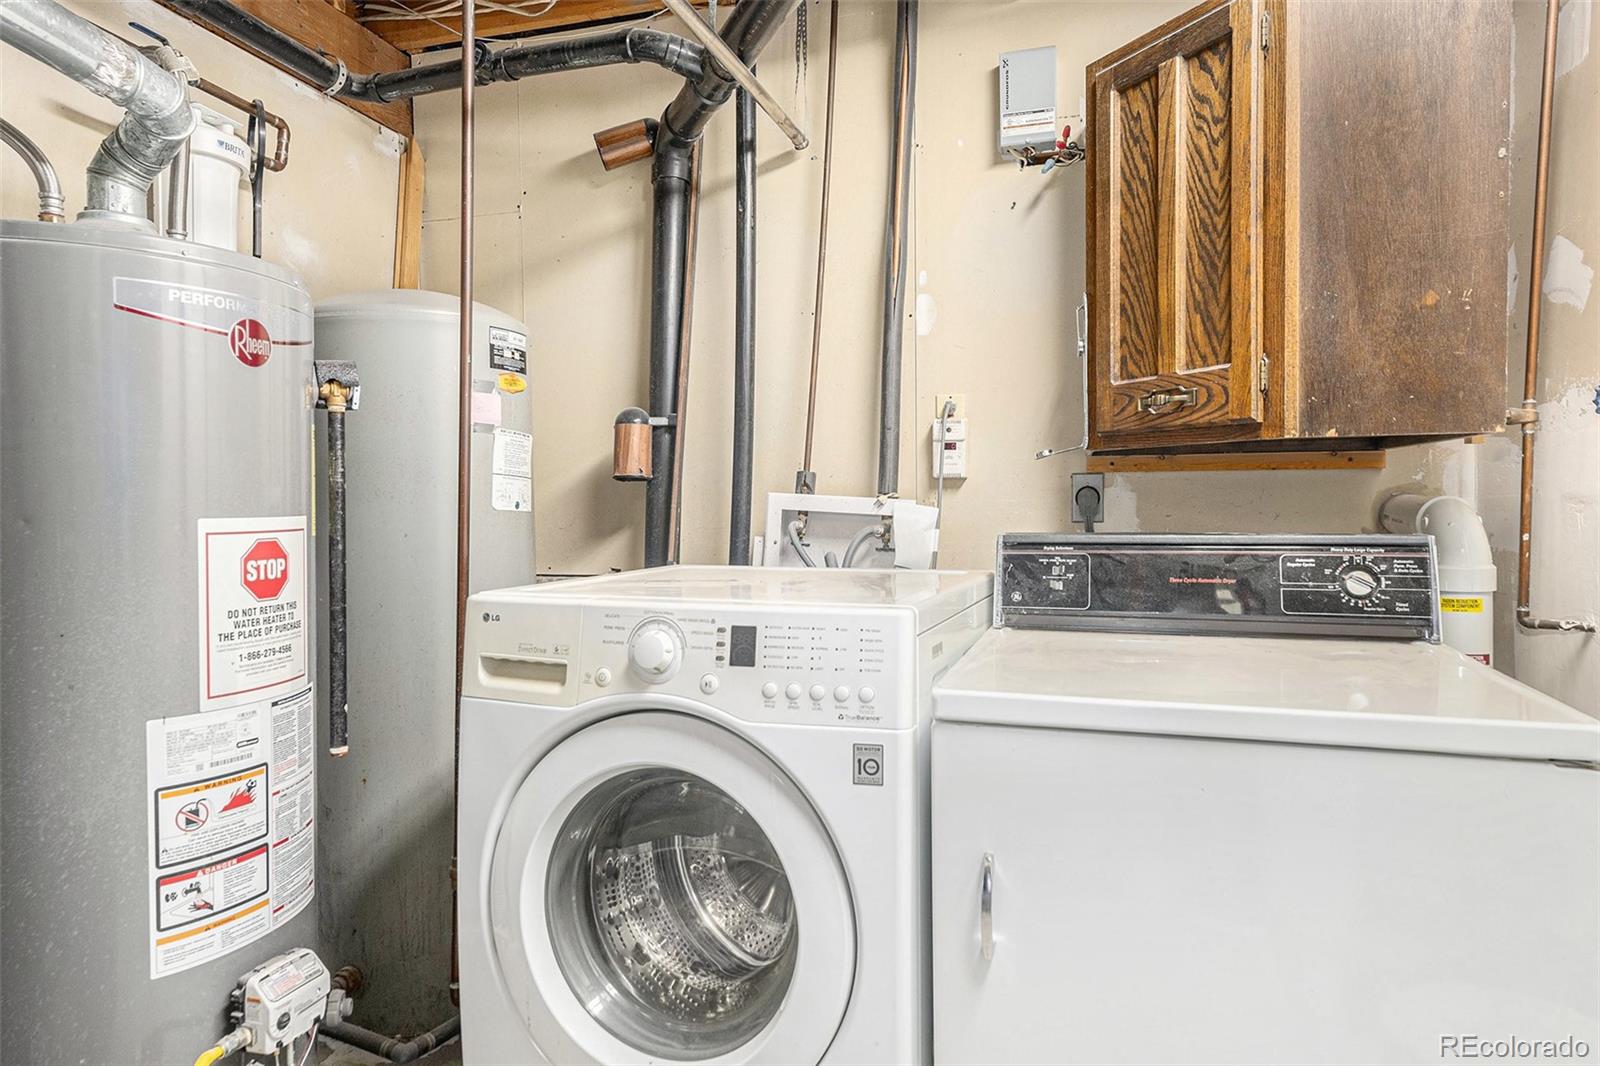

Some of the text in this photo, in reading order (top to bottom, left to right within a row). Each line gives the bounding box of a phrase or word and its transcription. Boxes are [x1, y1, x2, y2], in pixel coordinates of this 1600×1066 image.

[234, 319, 271, 360] Rheem
[246, 558, 286, 582] STOP
[227, 601, 297, 619] DO NOT RETURN THIS
[491, 614, 500, 622] LG
[233, 611, 294, 629] WATER HEATER TO
[218, 619, 302, 642] THE PLACE OF PURCHASE
[857, 758, 880, 776] 10
[204, 776, 242, 789] WARNING
